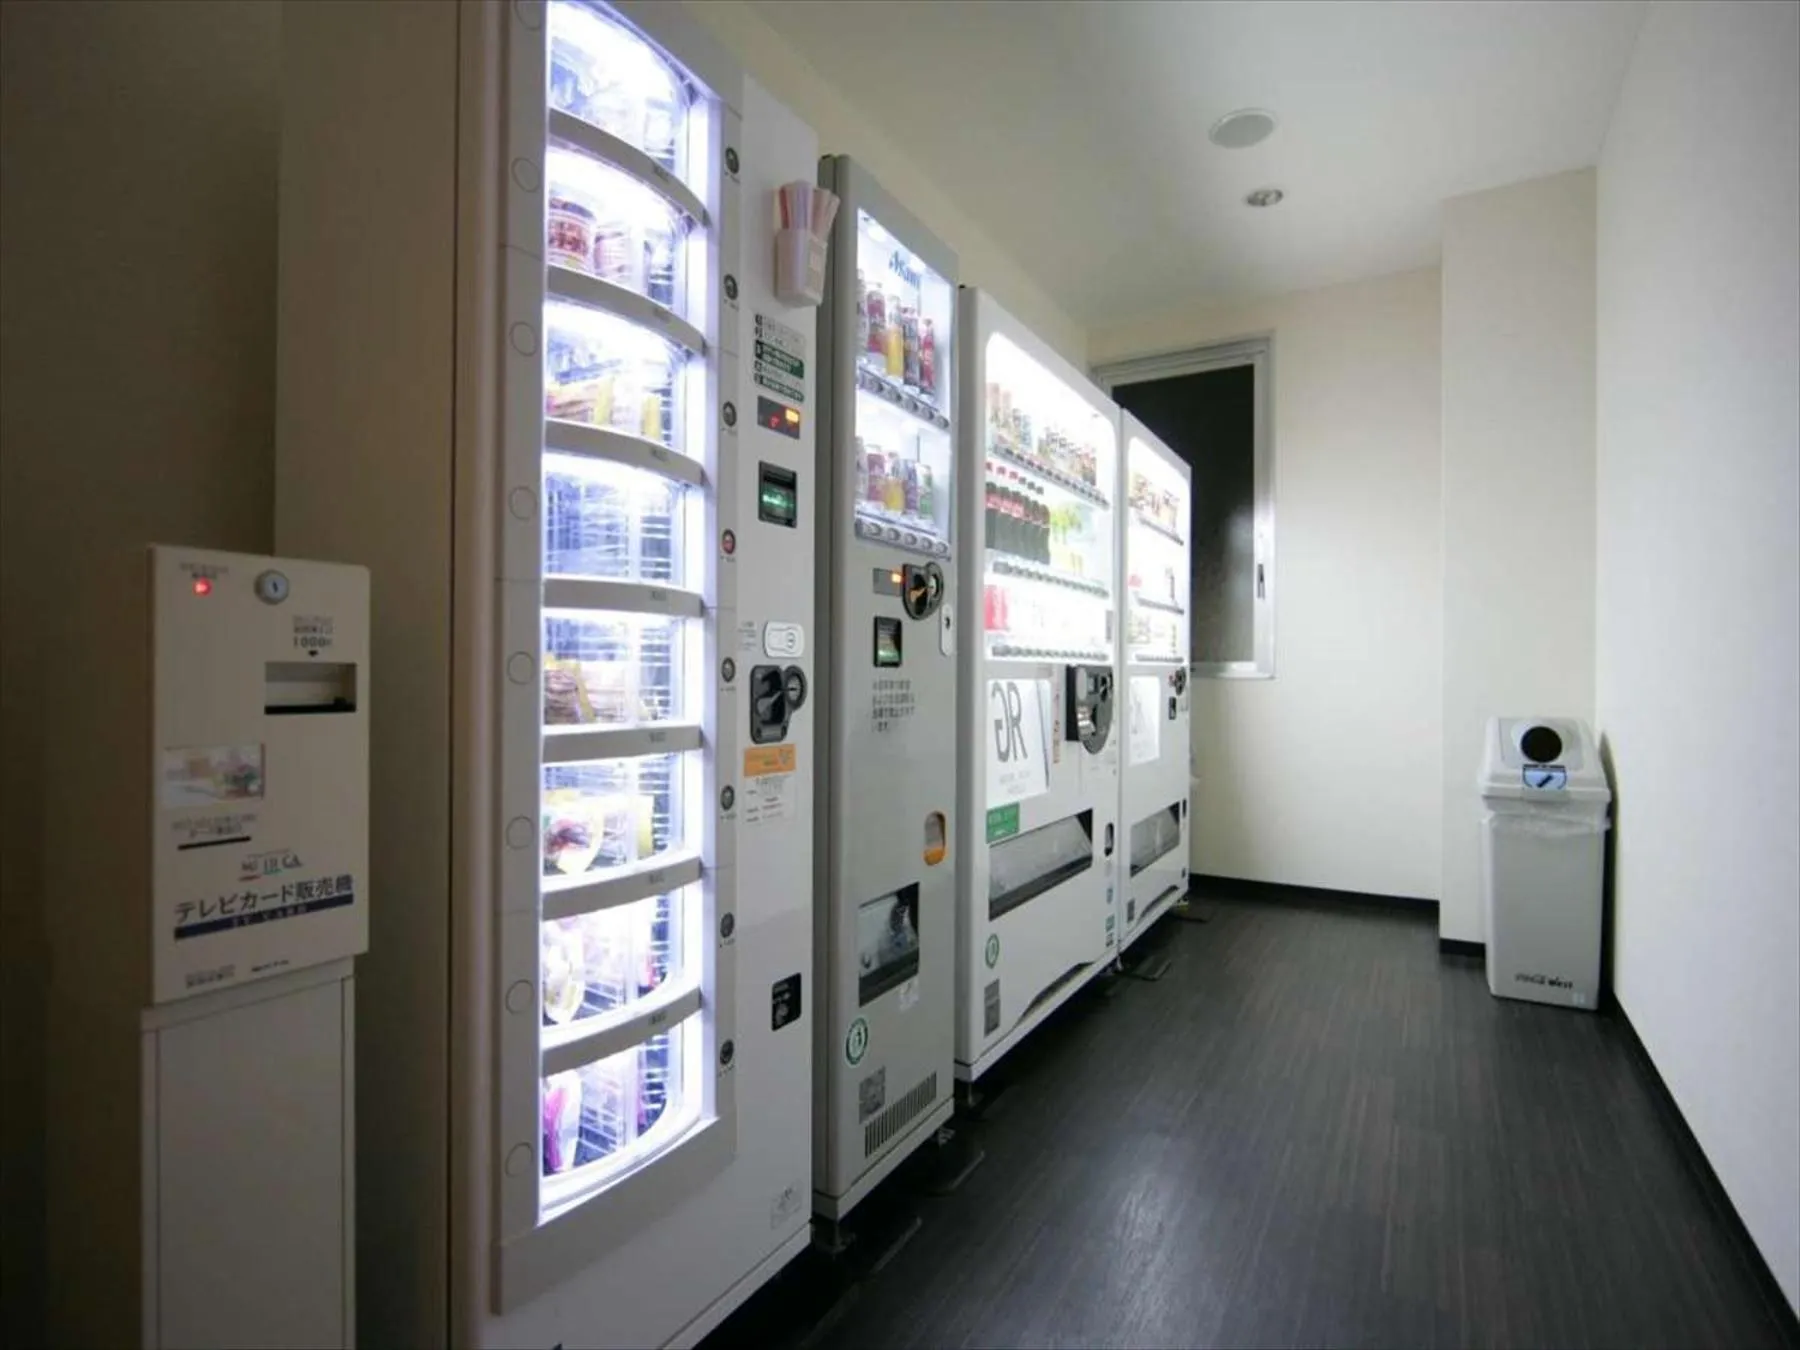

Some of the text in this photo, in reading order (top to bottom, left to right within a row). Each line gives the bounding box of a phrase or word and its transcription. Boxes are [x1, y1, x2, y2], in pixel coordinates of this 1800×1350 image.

[174, 873, 353, 924] テレビカード販売機
